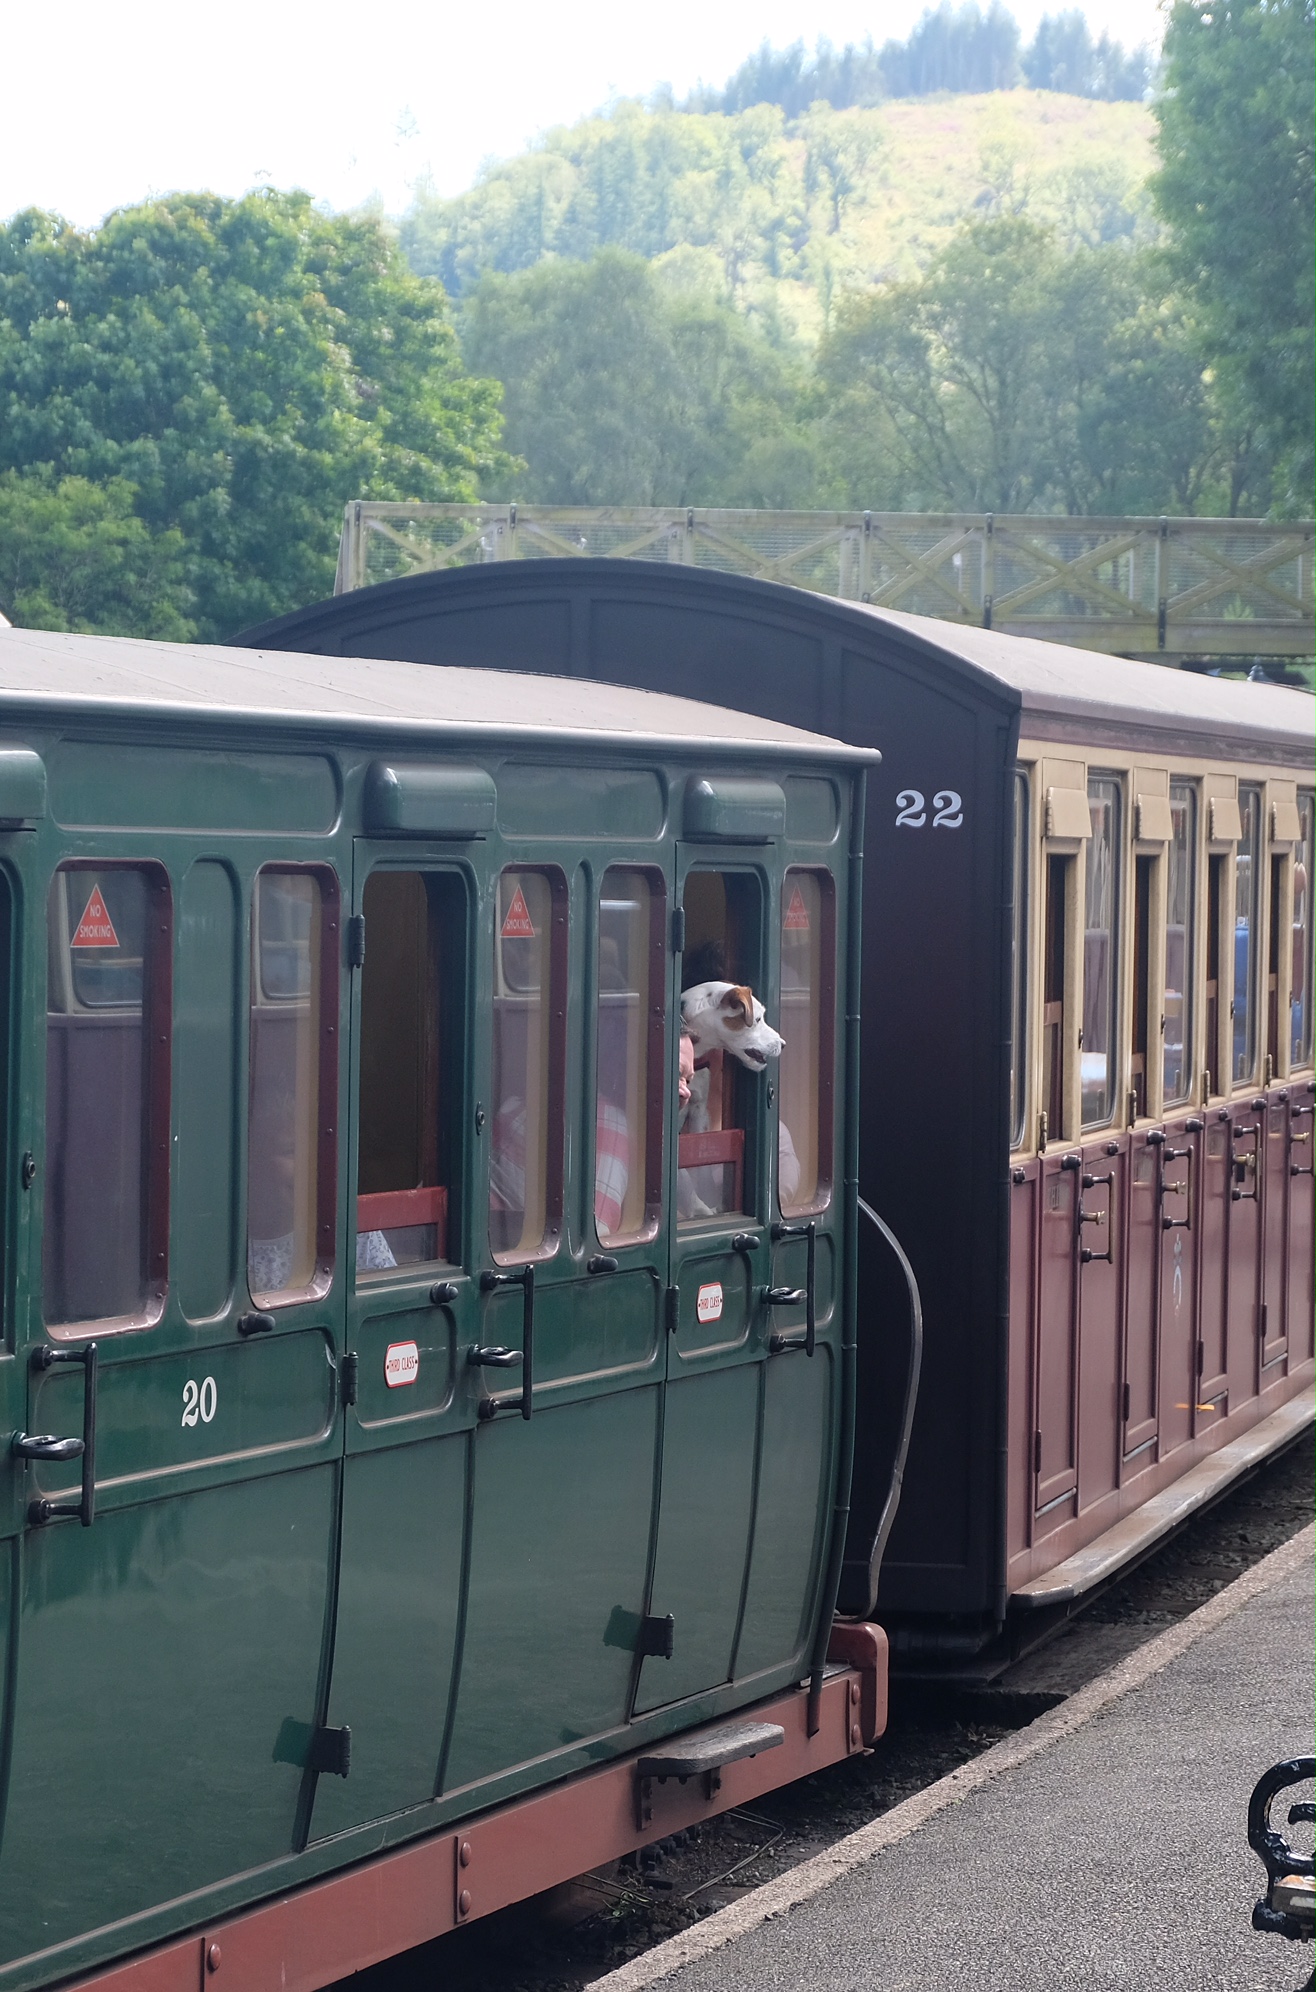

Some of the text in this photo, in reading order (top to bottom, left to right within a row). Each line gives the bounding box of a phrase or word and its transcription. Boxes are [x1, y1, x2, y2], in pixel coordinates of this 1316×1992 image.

[895, 789, 963, 828] 22
[89, 904, 101, 917] NO
[513, 901, 523, 912] NO
[506, 919, 530, 930] SMOKING
[79, 925, 111, 938] SMOKING
[401, 1355, 415, 1371] CLASS
[181, 1376, 217, 1427] 20
